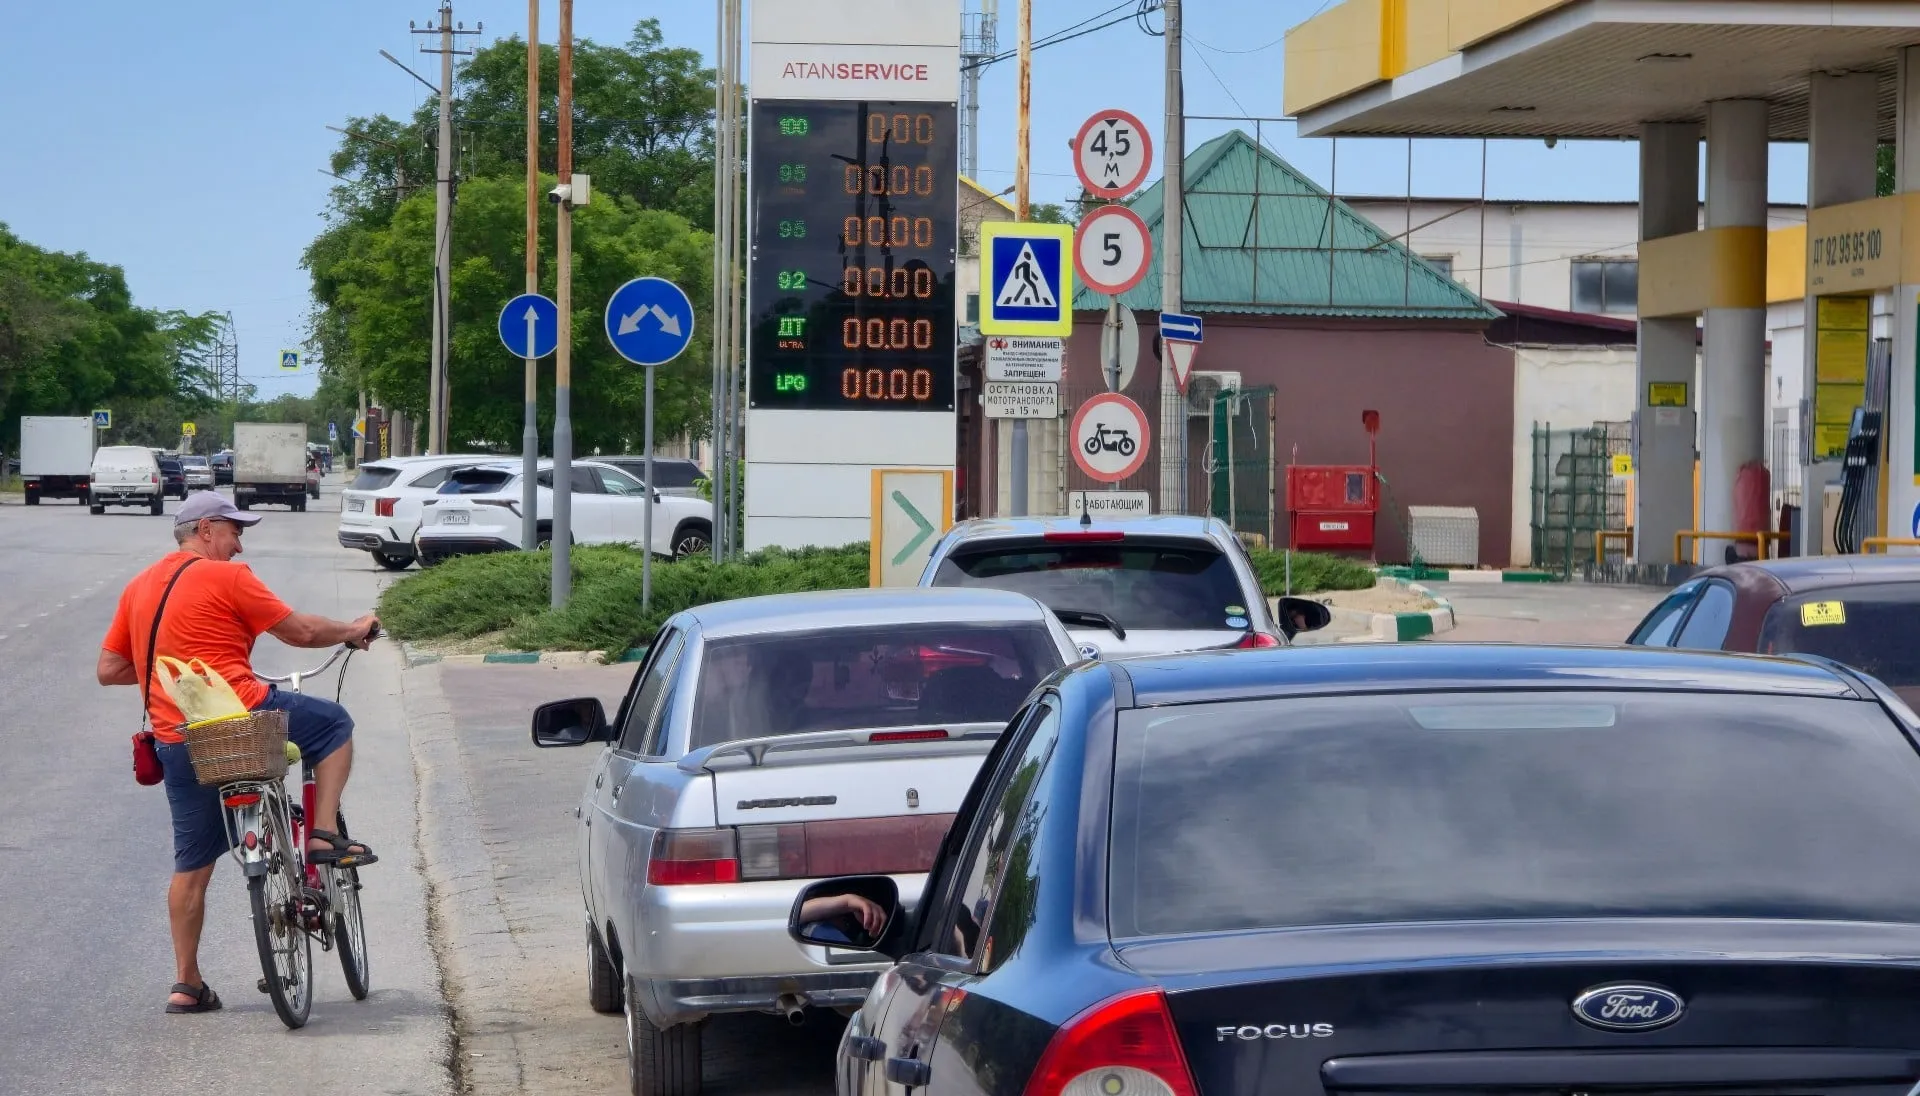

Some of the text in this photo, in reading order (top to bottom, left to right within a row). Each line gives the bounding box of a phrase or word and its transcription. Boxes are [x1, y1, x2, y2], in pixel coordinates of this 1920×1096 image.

[782, 62, 928, 81] ATANSERVICE
[780, 118, 808, 135] 100
[1090, 129, 1131, 161] 4,5
[779, 164, 934, 195] 95 00.00
[779, 216, 933, 247] 95 00.00
[1102, 233, 1122, 266] 5
[1826, 236, 1837, 266] 92
[1839, 233, 1851, 264] 95
[1852, 232, 1864, 262] 95
[1866, 229, 1881, 260] 100
[778, 266, 932, 298] 92 00.00
[777, 317, 932, 349] ДТ 00.00
[1012, 340, 1060, 349] ВНИМАНИЕ!
[776, 368, 931, 399] LPG 00.00
[1003, 369, 1046, 379] ЗАПРЕЩЕН!
[987, 396, 1055, 406] МОТОТРАНСПОРТА
[989, 385, 1053, 395] ОСТАНОВКА
[1020, 406, 1029, 415] 15
[1601, 994, 1659, 1018] Ford
[1216, 1023, 1334, 1042] FOCUS
